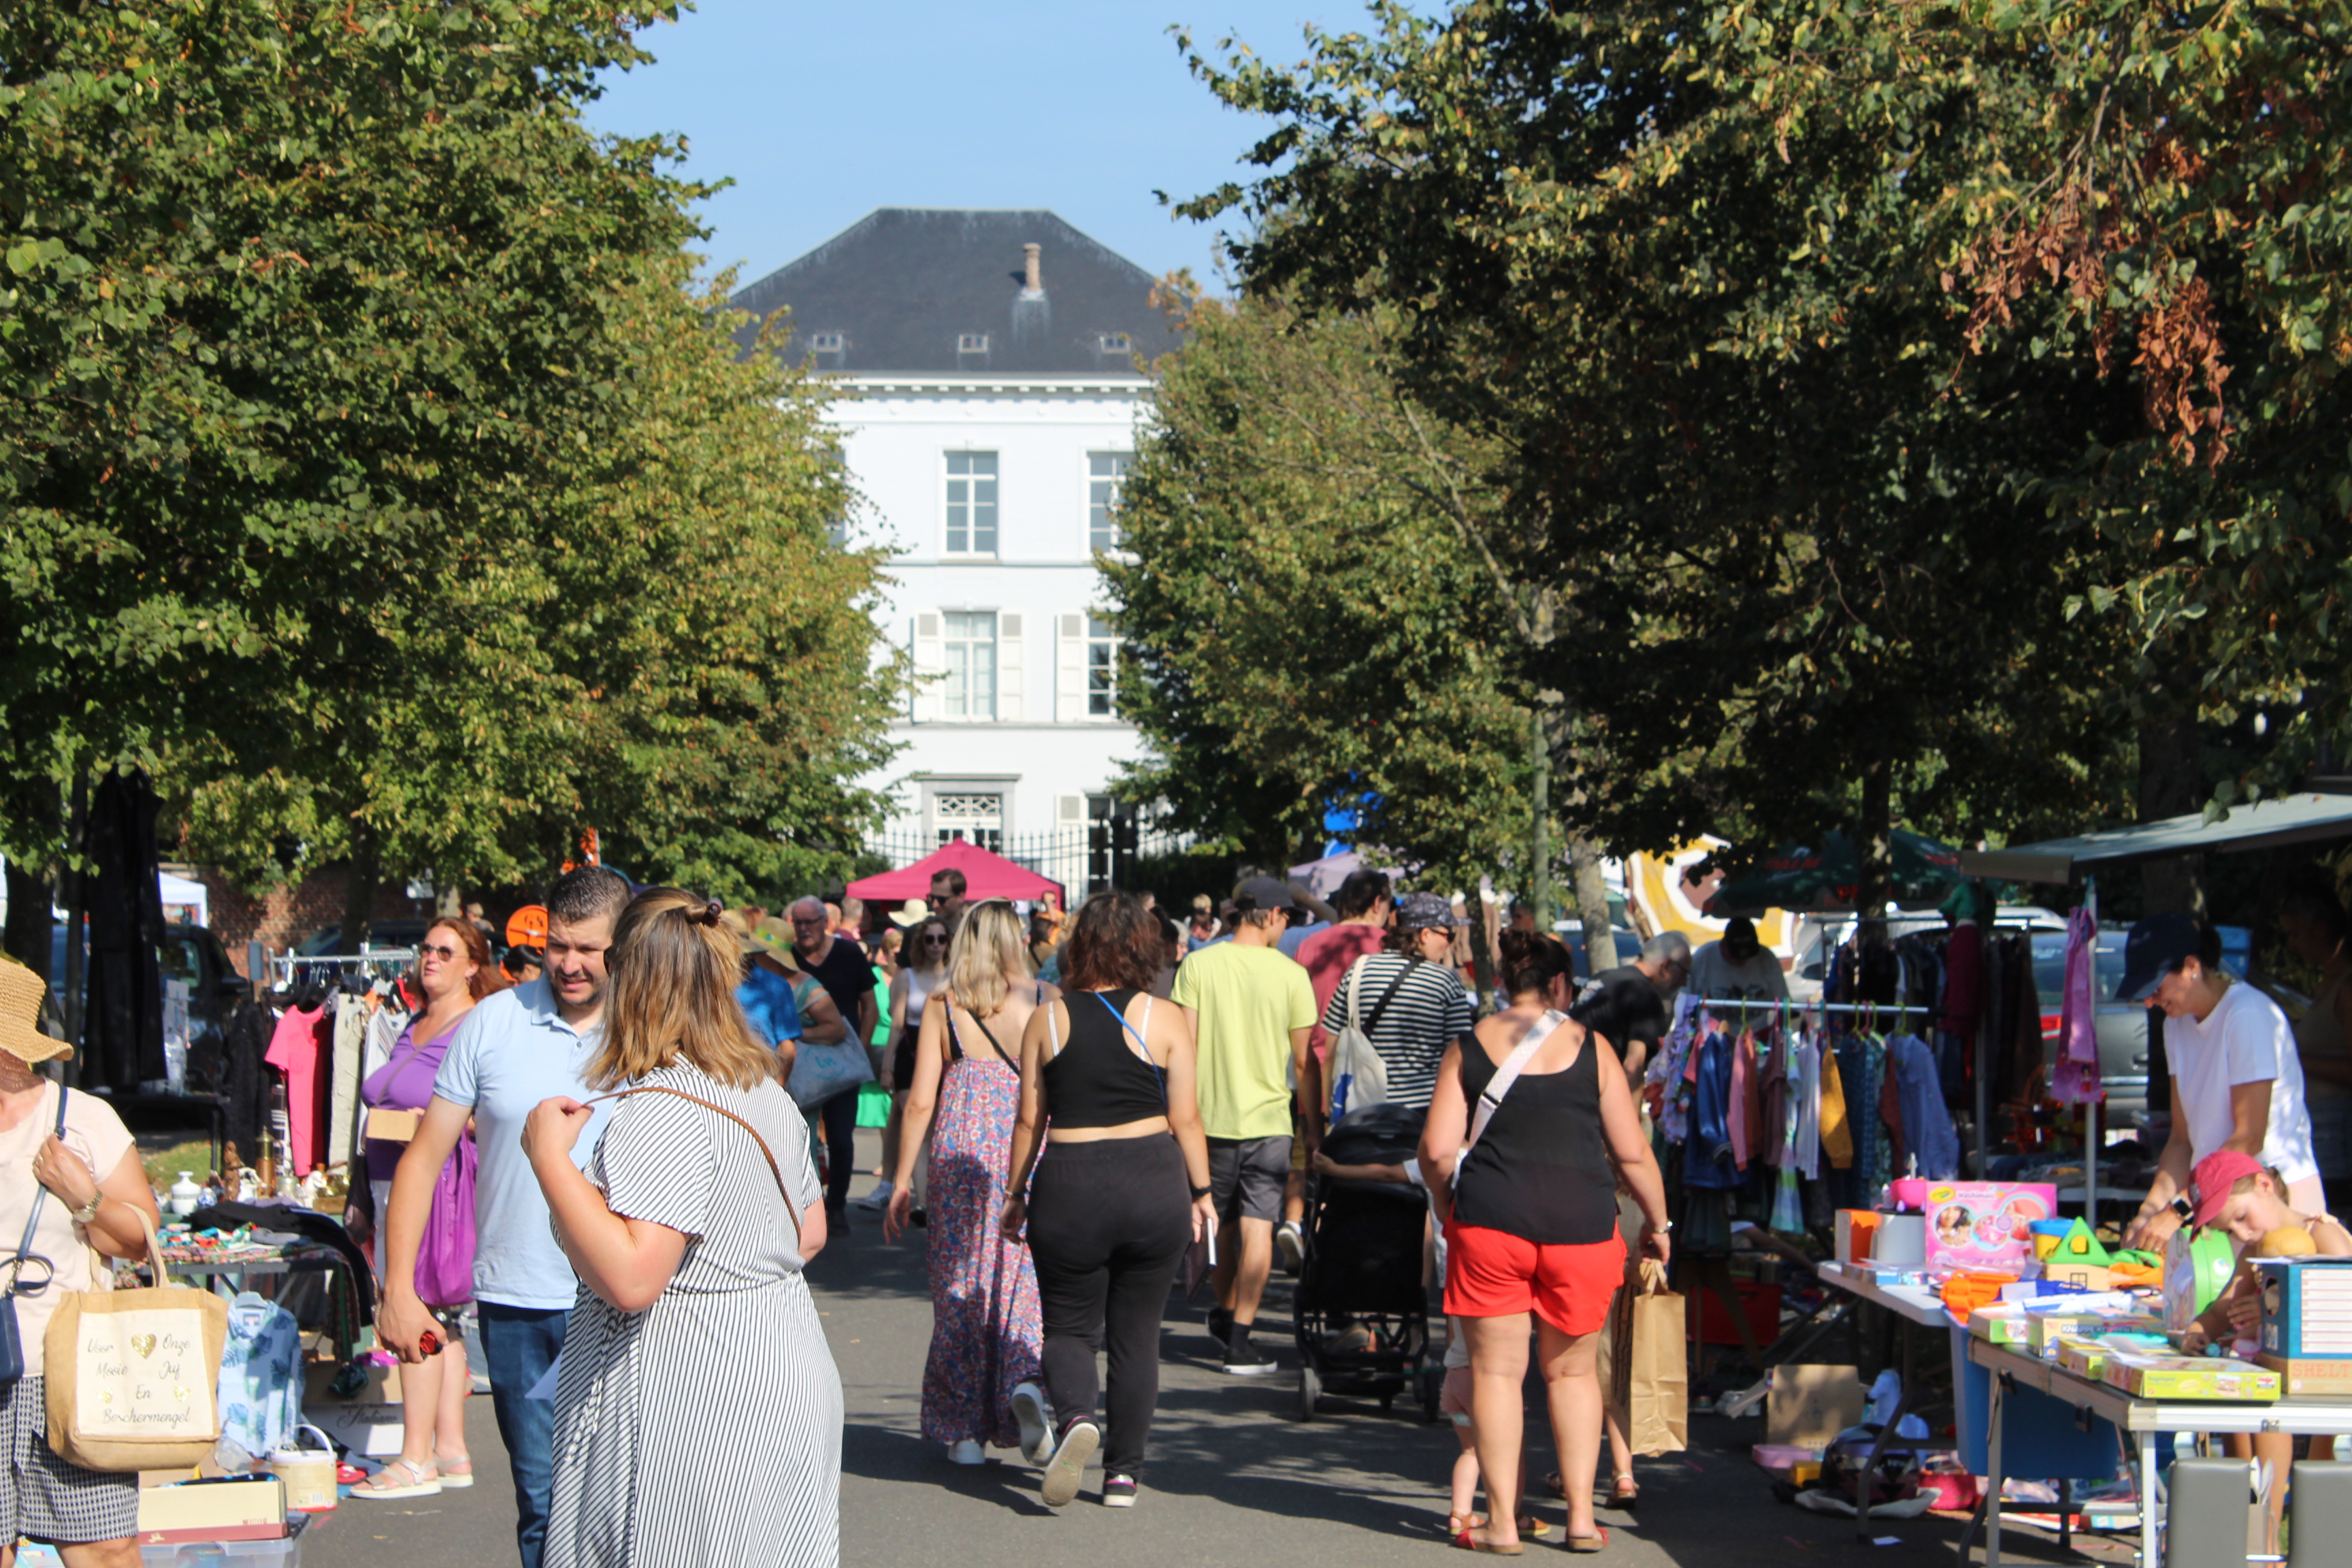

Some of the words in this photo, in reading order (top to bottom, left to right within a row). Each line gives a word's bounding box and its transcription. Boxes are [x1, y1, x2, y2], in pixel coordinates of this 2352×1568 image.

[87, 1338, 114, 1353] Voor
[163, 1333, 190, 1356] Onze
[96, 1362, 128, 1379] Mooie
[159, 1360, 180, 1380] Juf
[135, 1384, 150, 1400] En
[103, 1406, 191, 1429] Beschermengel
